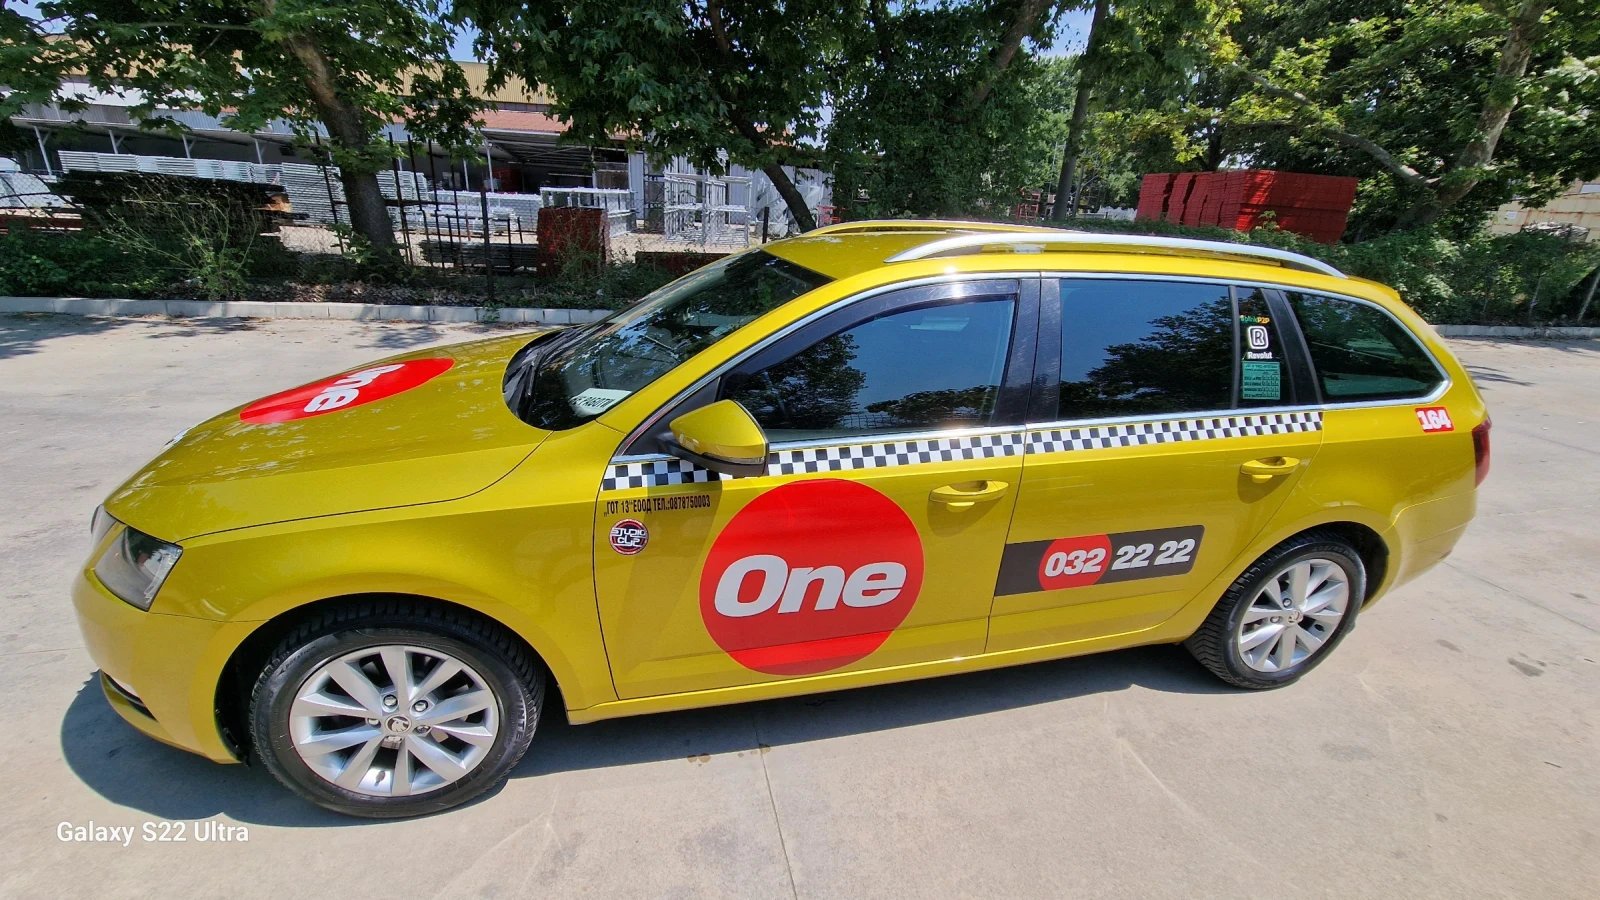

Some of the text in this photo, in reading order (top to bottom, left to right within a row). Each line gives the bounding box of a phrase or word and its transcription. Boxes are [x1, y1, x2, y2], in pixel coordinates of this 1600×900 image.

[1247, 351, 1273, 360] Revolut
[1416, 409, 1452, 430] 164
[1044, 538, 1196, 577] 032 22 22
[714, 554, 907, 618] One
